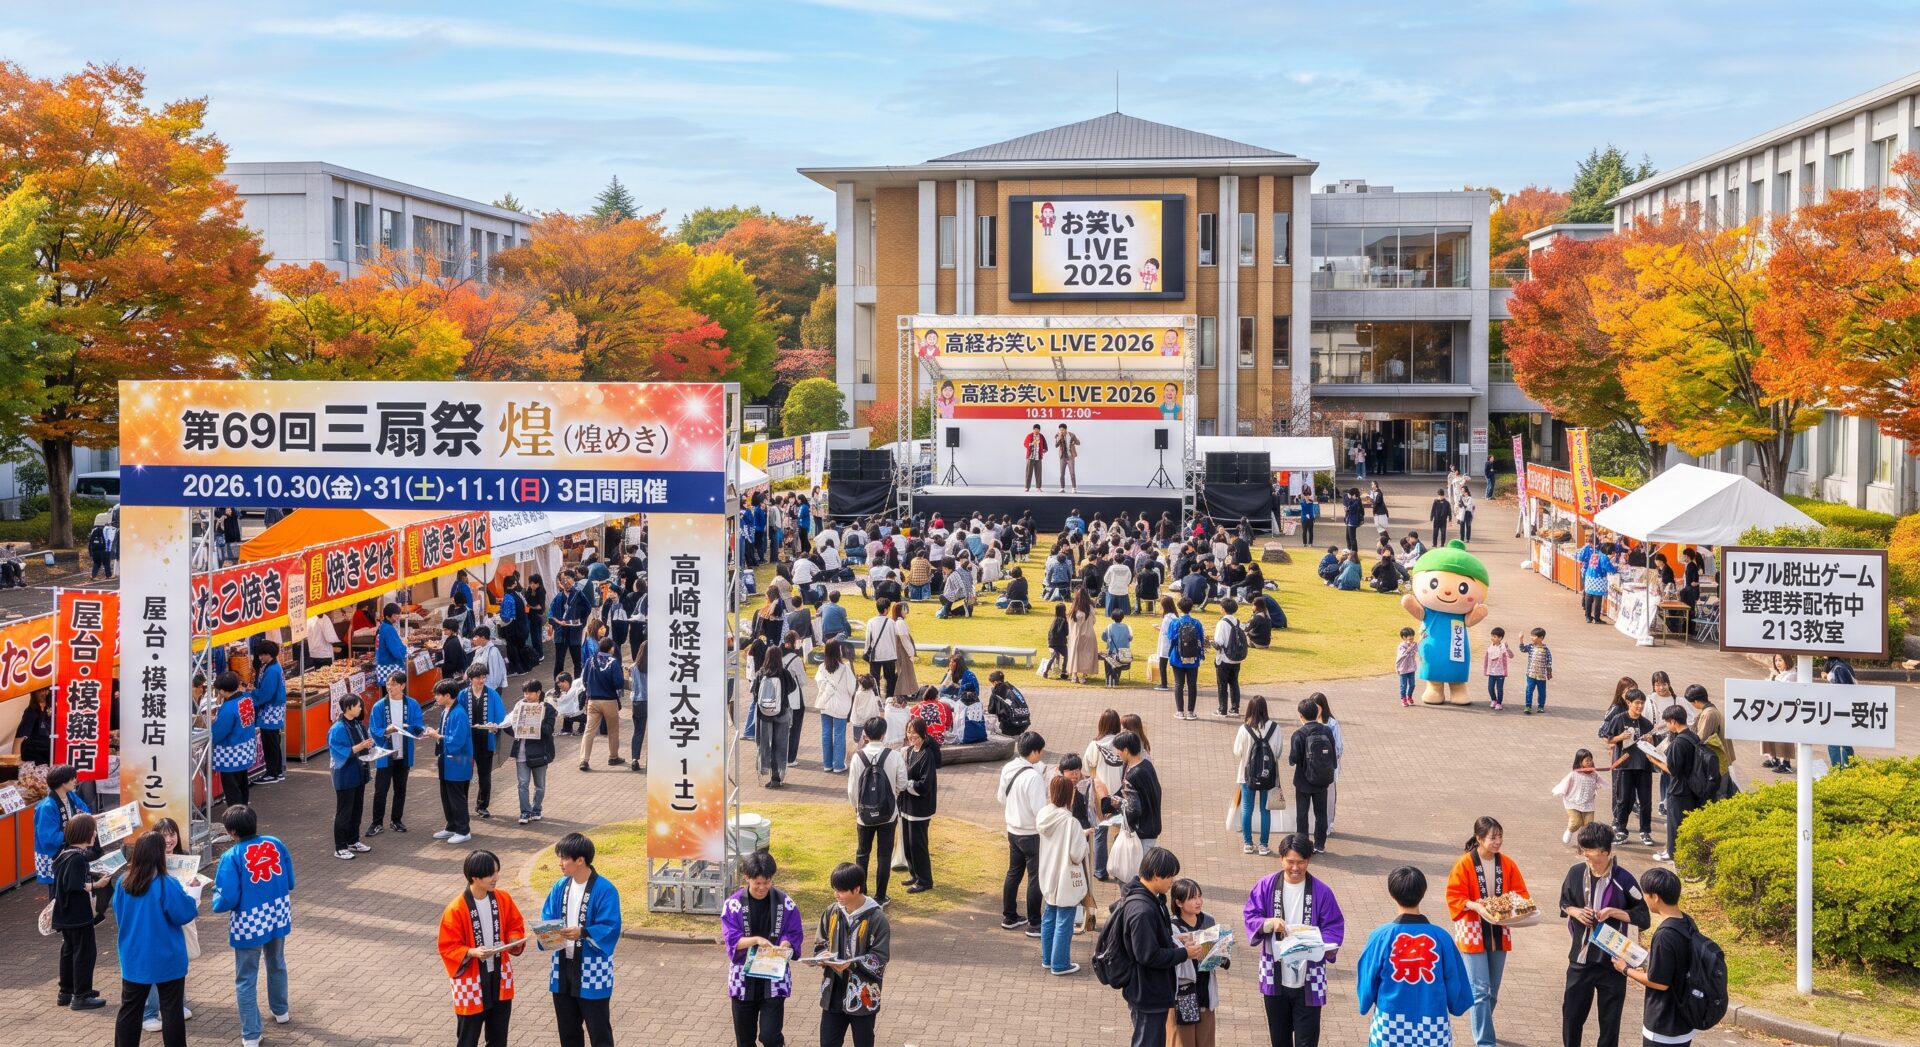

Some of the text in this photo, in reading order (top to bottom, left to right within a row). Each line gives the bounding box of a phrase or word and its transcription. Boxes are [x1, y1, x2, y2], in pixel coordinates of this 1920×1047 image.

[1061, 210, 1135, 235] お笑い
[1067, 238, 1128, 260] L!VE
[1063, 264, 1132, 286] 2026
[945, 332, 1154, 353] 高経お笑い L!VE 2026
[961, 384, 1156, 404] 高経お笑い L!VE 2026
[1026, 408, 1053, 418] 10.31
[557, 478, 668, 504] 3日間開催
[422, 515, 487, 567] 焼きそば
[327, 536, 396, 595] 焼きそば
[1732, 561, 1875, 588] リアル脱出ゲーム
[192, 568, 281, 633] たこ焼き
[1742, 589, 1864, 617] 整理券配布中
[1762, 619, 1845, 644] 213教室
[2, 640, 53, 688] たこ
[1732, 698, 1888, 730] スタンプラリー受付
